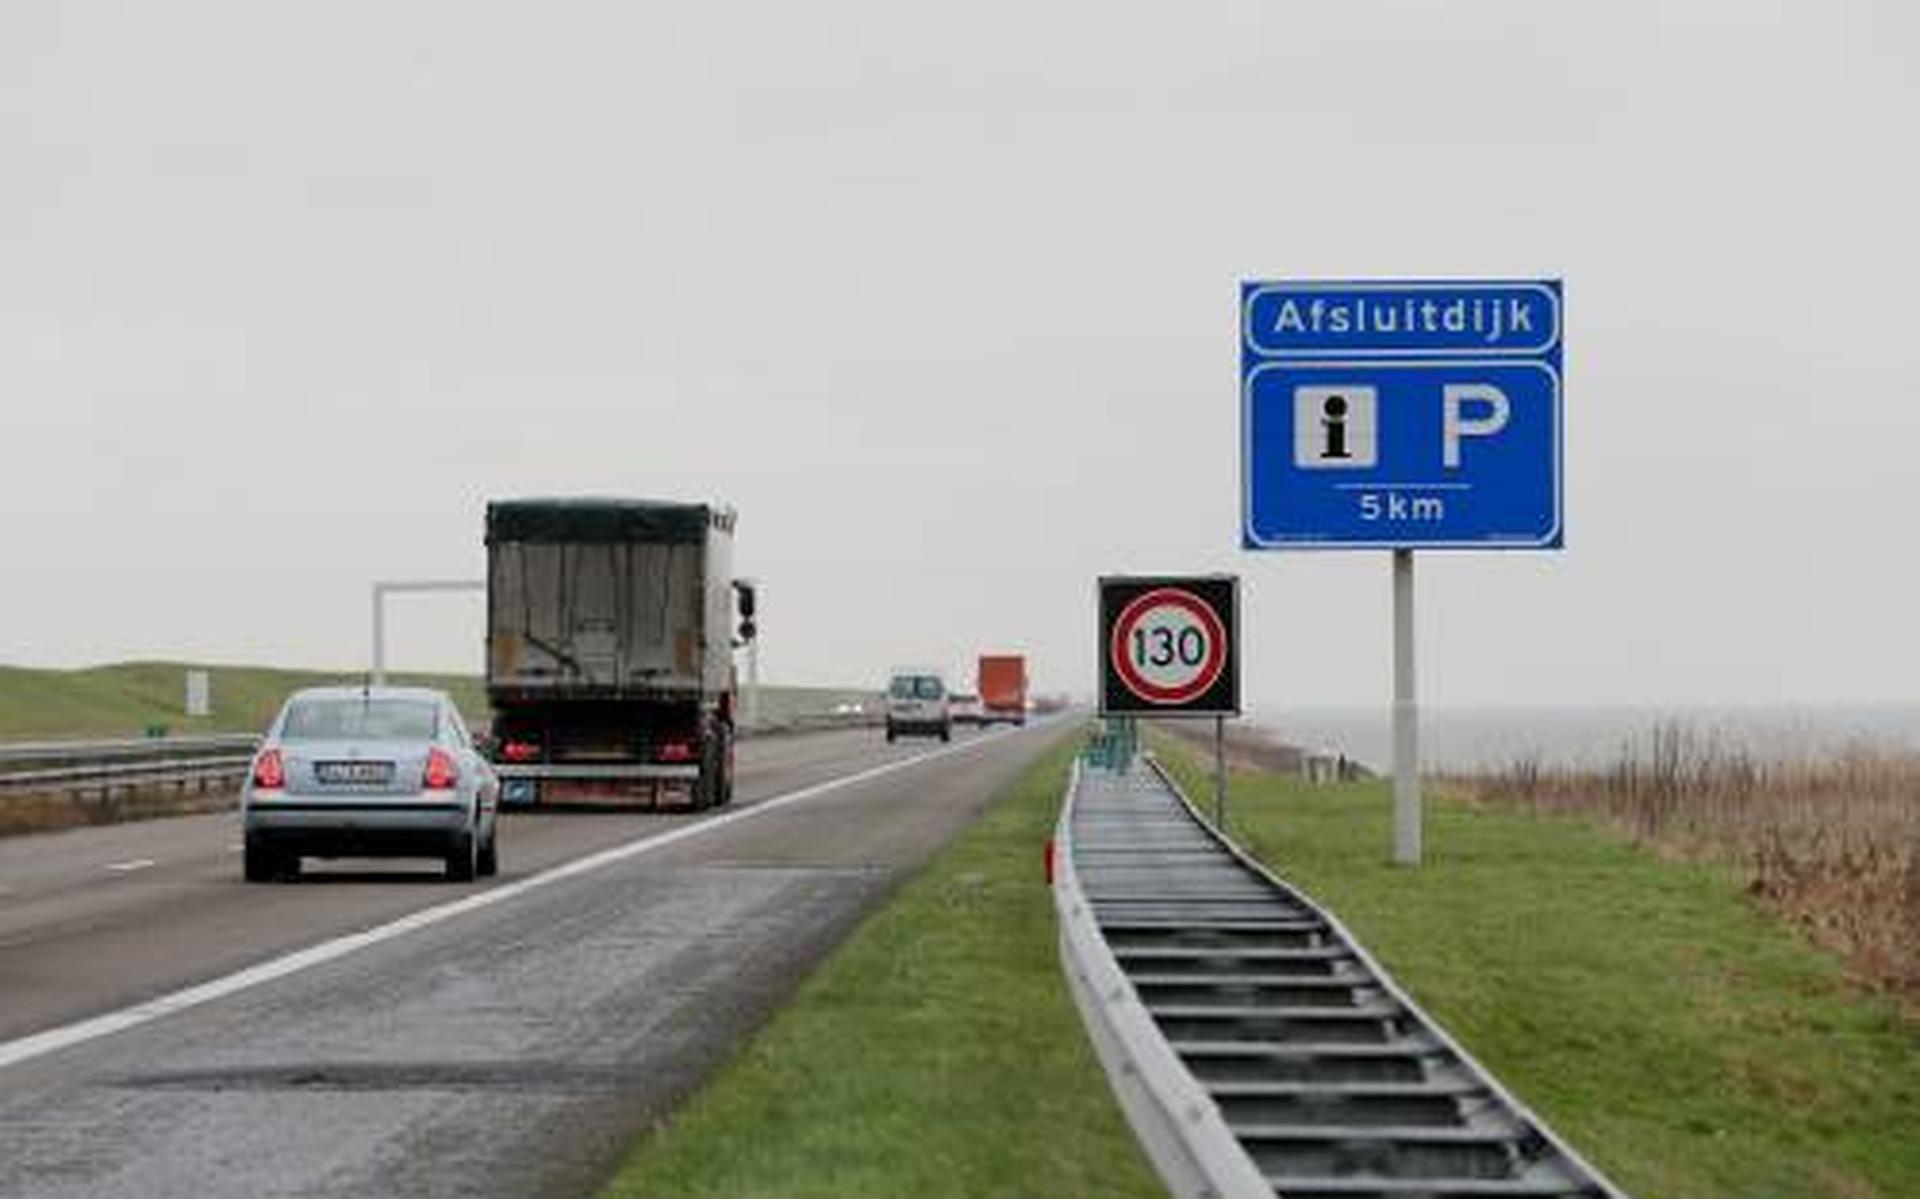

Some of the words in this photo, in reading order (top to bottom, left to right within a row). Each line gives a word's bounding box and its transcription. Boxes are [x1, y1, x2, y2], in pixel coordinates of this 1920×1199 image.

[1273, 299, 1532, 342] Afsluitdijk
[1443, 383, 1510, 467] P
[1134, 626, 1205, 666] 130
